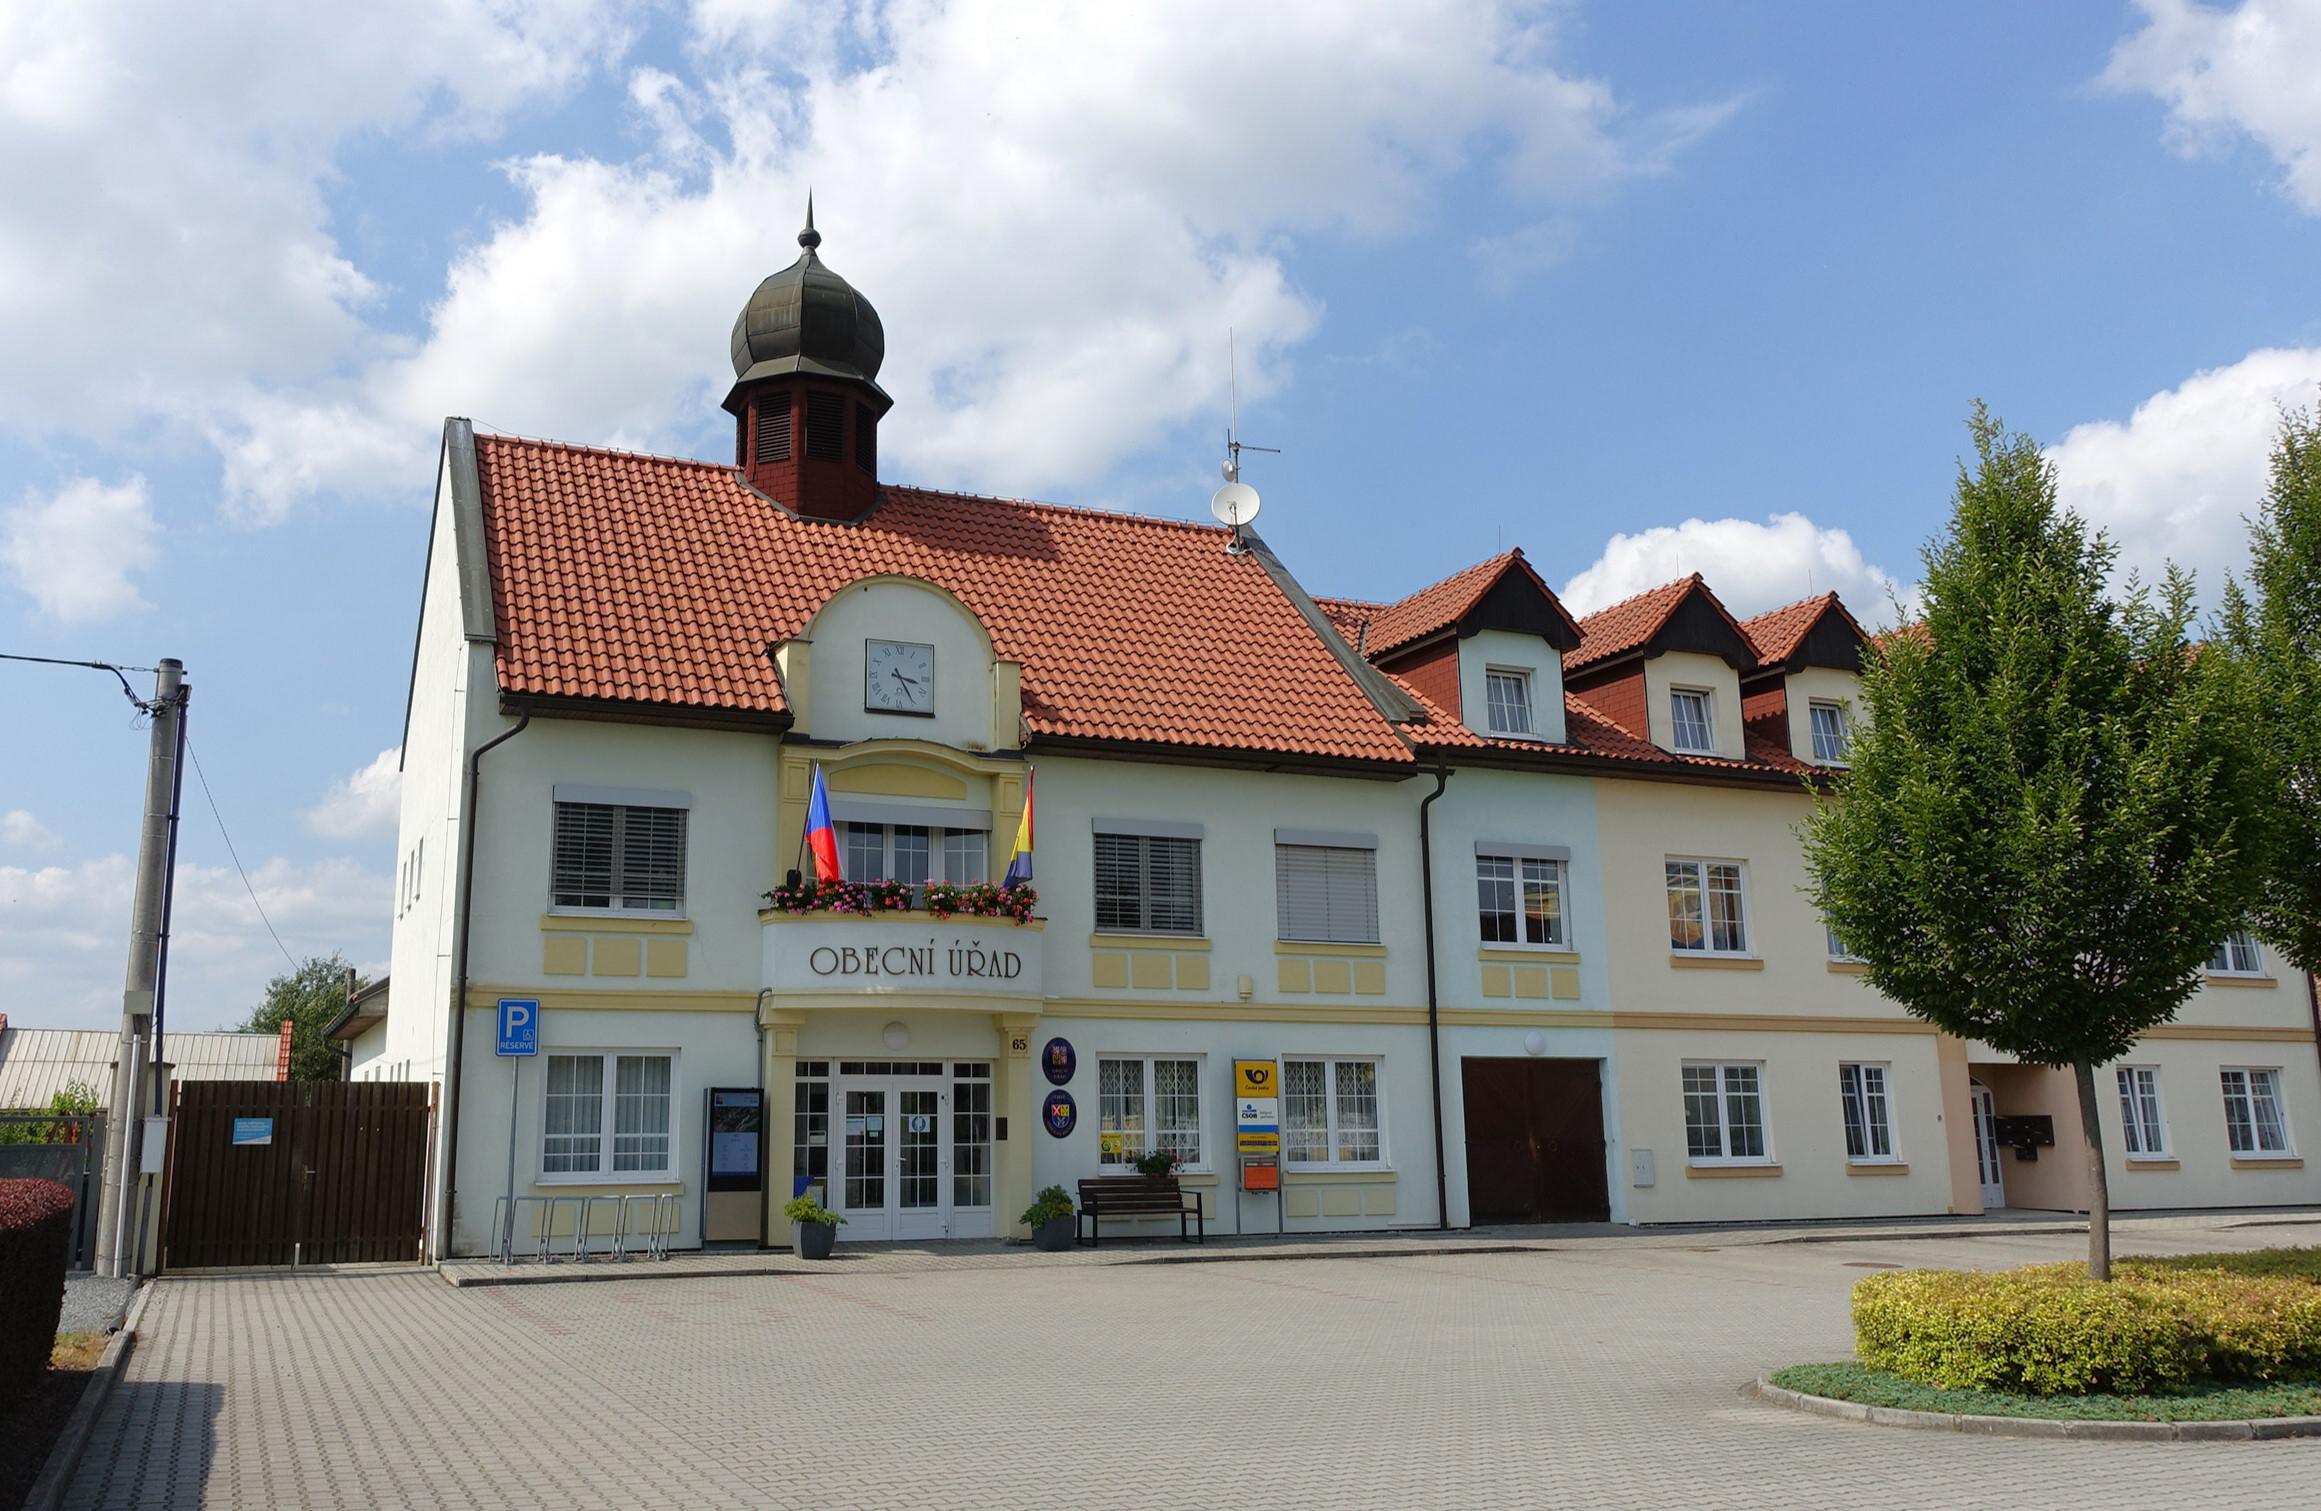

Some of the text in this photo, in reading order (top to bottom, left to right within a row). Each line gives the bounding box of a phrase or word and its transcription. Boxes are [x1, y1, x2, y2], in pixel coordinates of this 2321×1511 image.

[809, 938, 1022, 979] OBECNÍ ÚŘAD
[506, 1006, 529, 1038] P
[1012, 1039, 1027, 1050] 65
